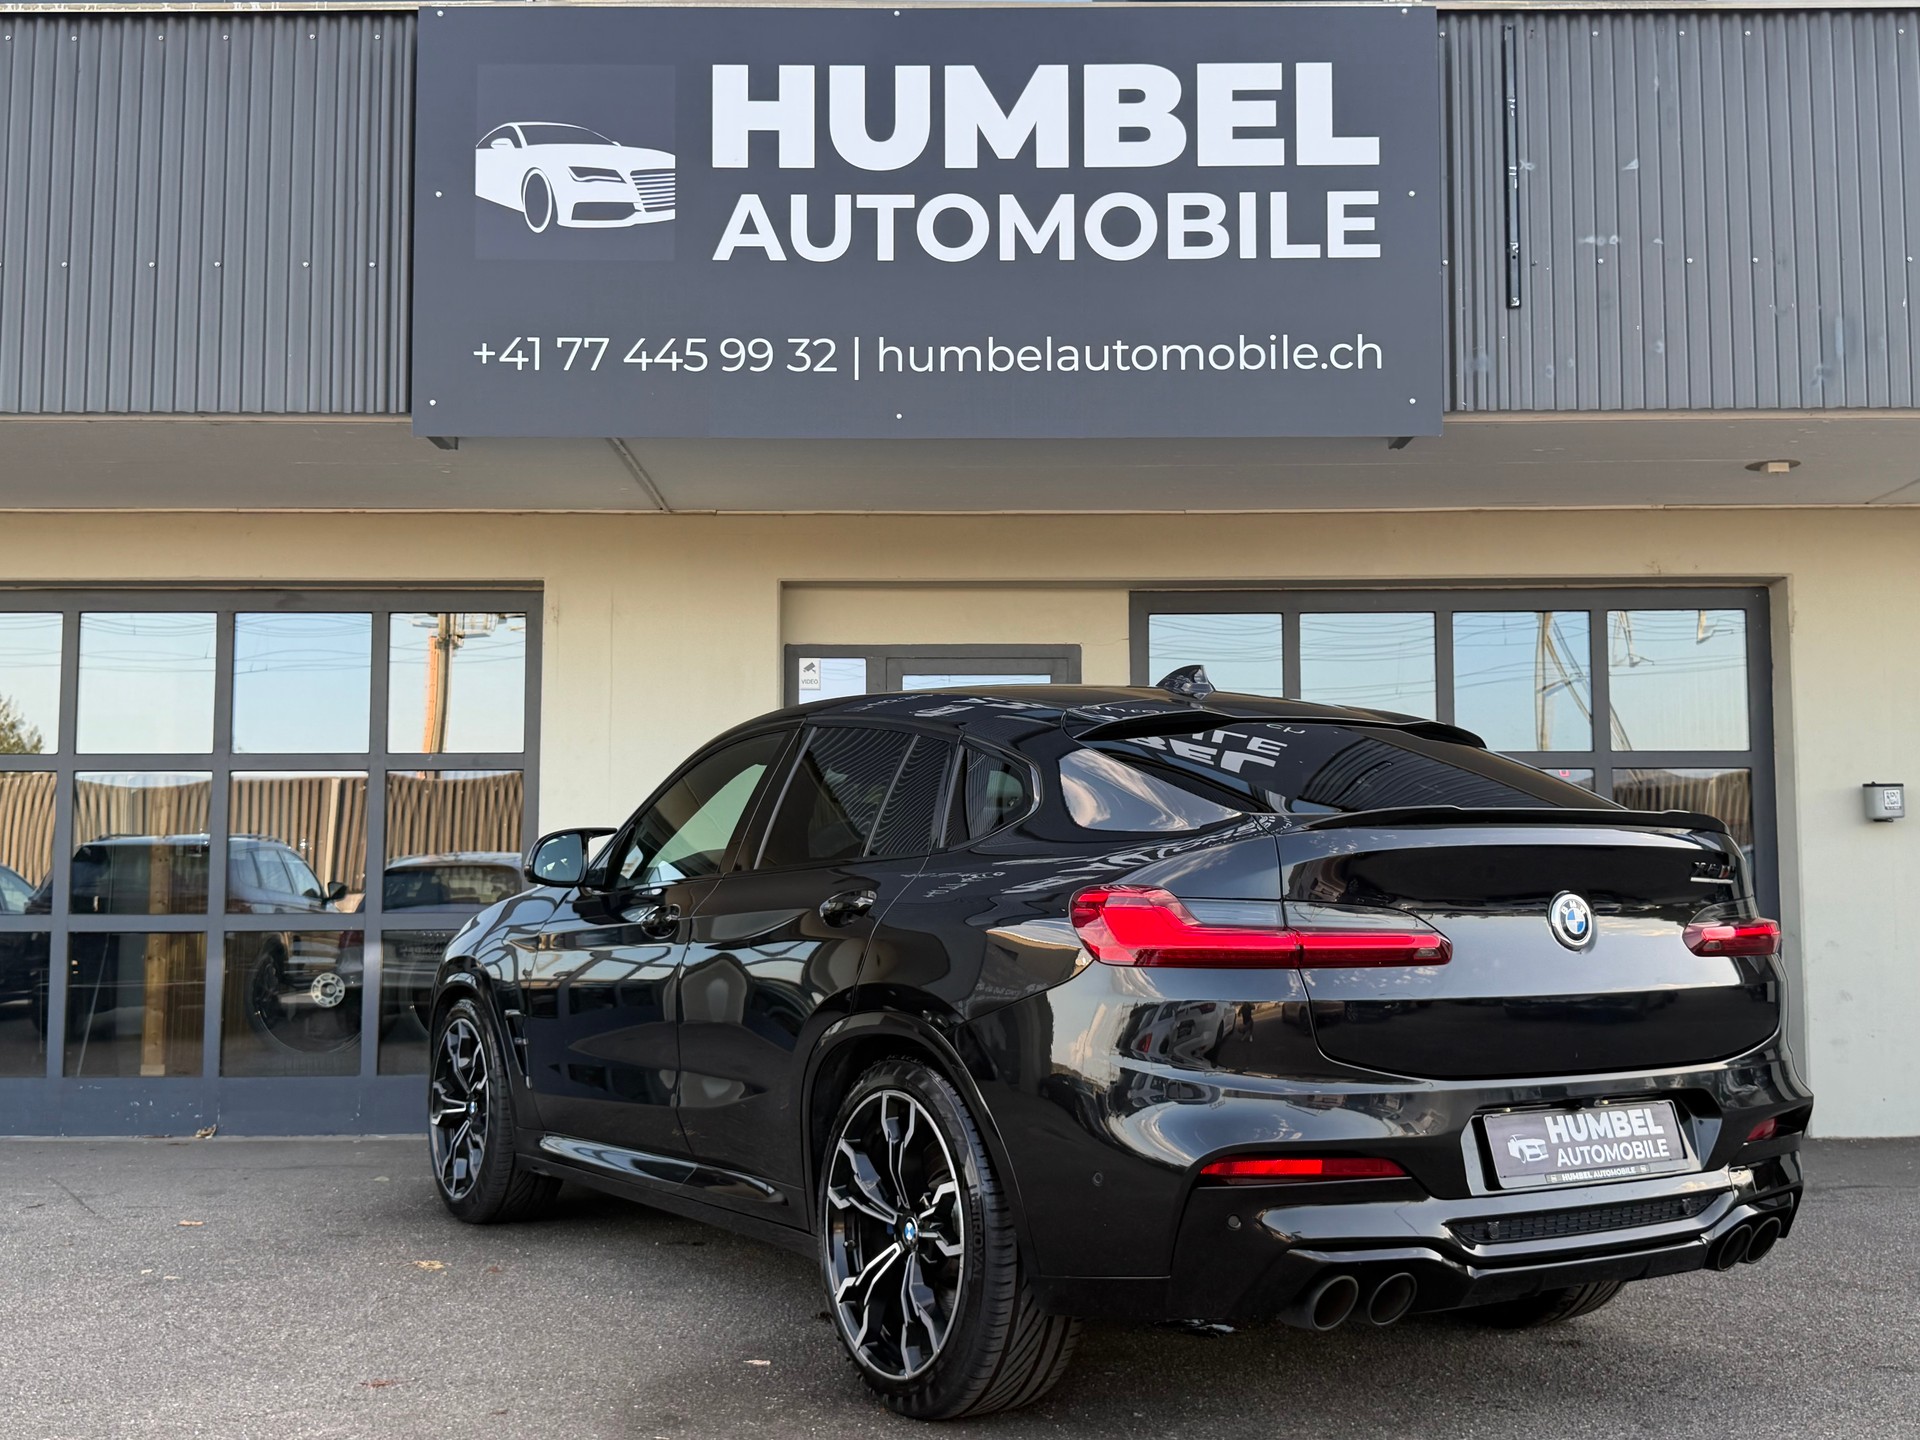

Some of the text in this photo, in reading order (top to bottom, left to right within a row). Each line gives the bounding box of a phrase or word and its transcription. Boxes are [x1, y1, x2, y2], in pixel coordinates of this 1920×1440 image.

[711, 62, 1380, 171] HUMBEL
[712, 191, 1381, 263] AUTOMOBILE
[473, 337, 541, 371] +41
[556, 337, 610, 372] 77
[623, 337, 708, 372] 445
[719, 338, 774, 373] 99
[786, 338, 838, 373] 32
[878, 333, 1383, 373] humbelautomobile.ch
[1544, 1108, 1664, 1144] HUMBEL
[1557, 1138, 1670, 1167] AUTOMOBILE
[1561, 1166, 1637, 1182] HUMBEL AUTOMOBILE
[967, 1184, 985, 1283] UNIROYAL
